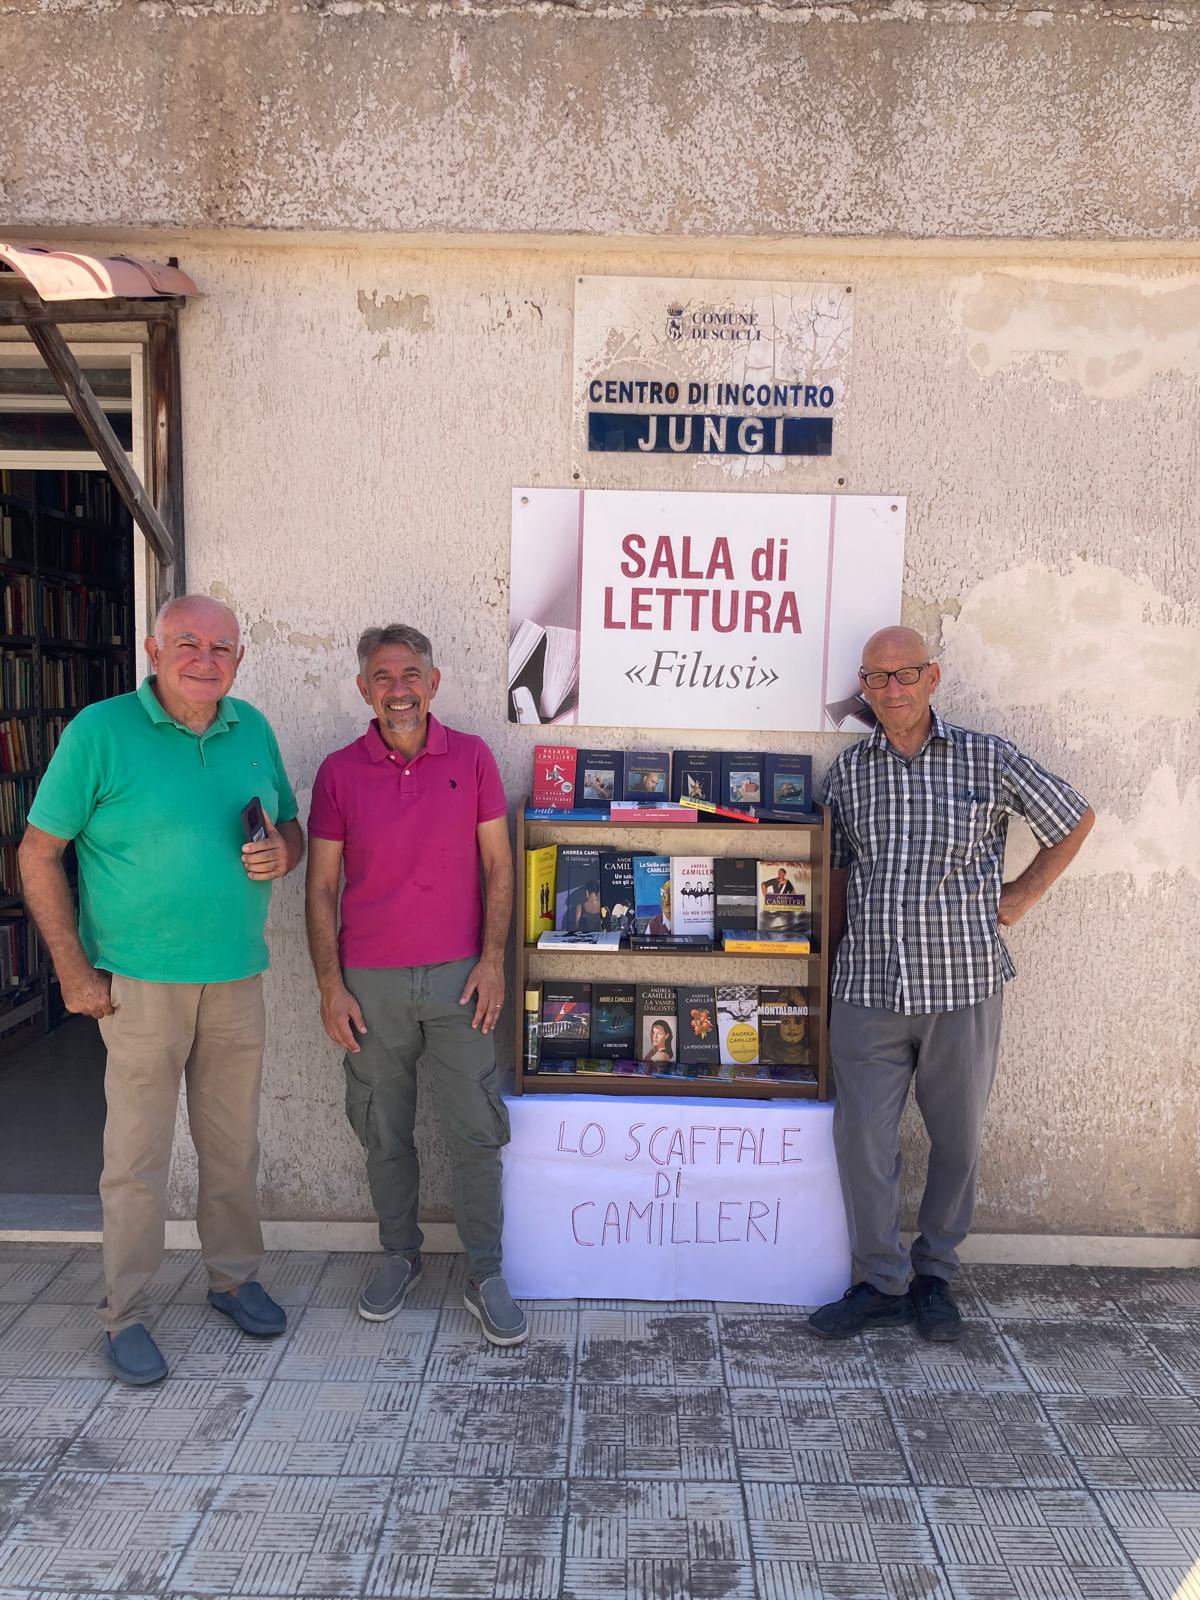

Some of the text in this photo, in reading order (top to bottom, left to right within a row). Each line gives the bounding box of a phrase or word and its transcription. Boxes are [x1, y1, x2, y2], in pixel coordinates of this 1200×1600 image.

[692, 312, 759, 326] COMUNE
[692, 328, 761, 341] DI SCICLI
[589, 380, 835, 407] CENTRO DI INCONTRO
[637, 414, 784, 454] JUNGI
[620, 533, 788, 582] SALA di
[603, 586, 802, 634] LETTURA
[624, 649, 779, 690] «Filusi»
[757, 1006, 809, 1016] MONTALBANO
[557, 1121, 802, 1166] LO SCAFFALE
